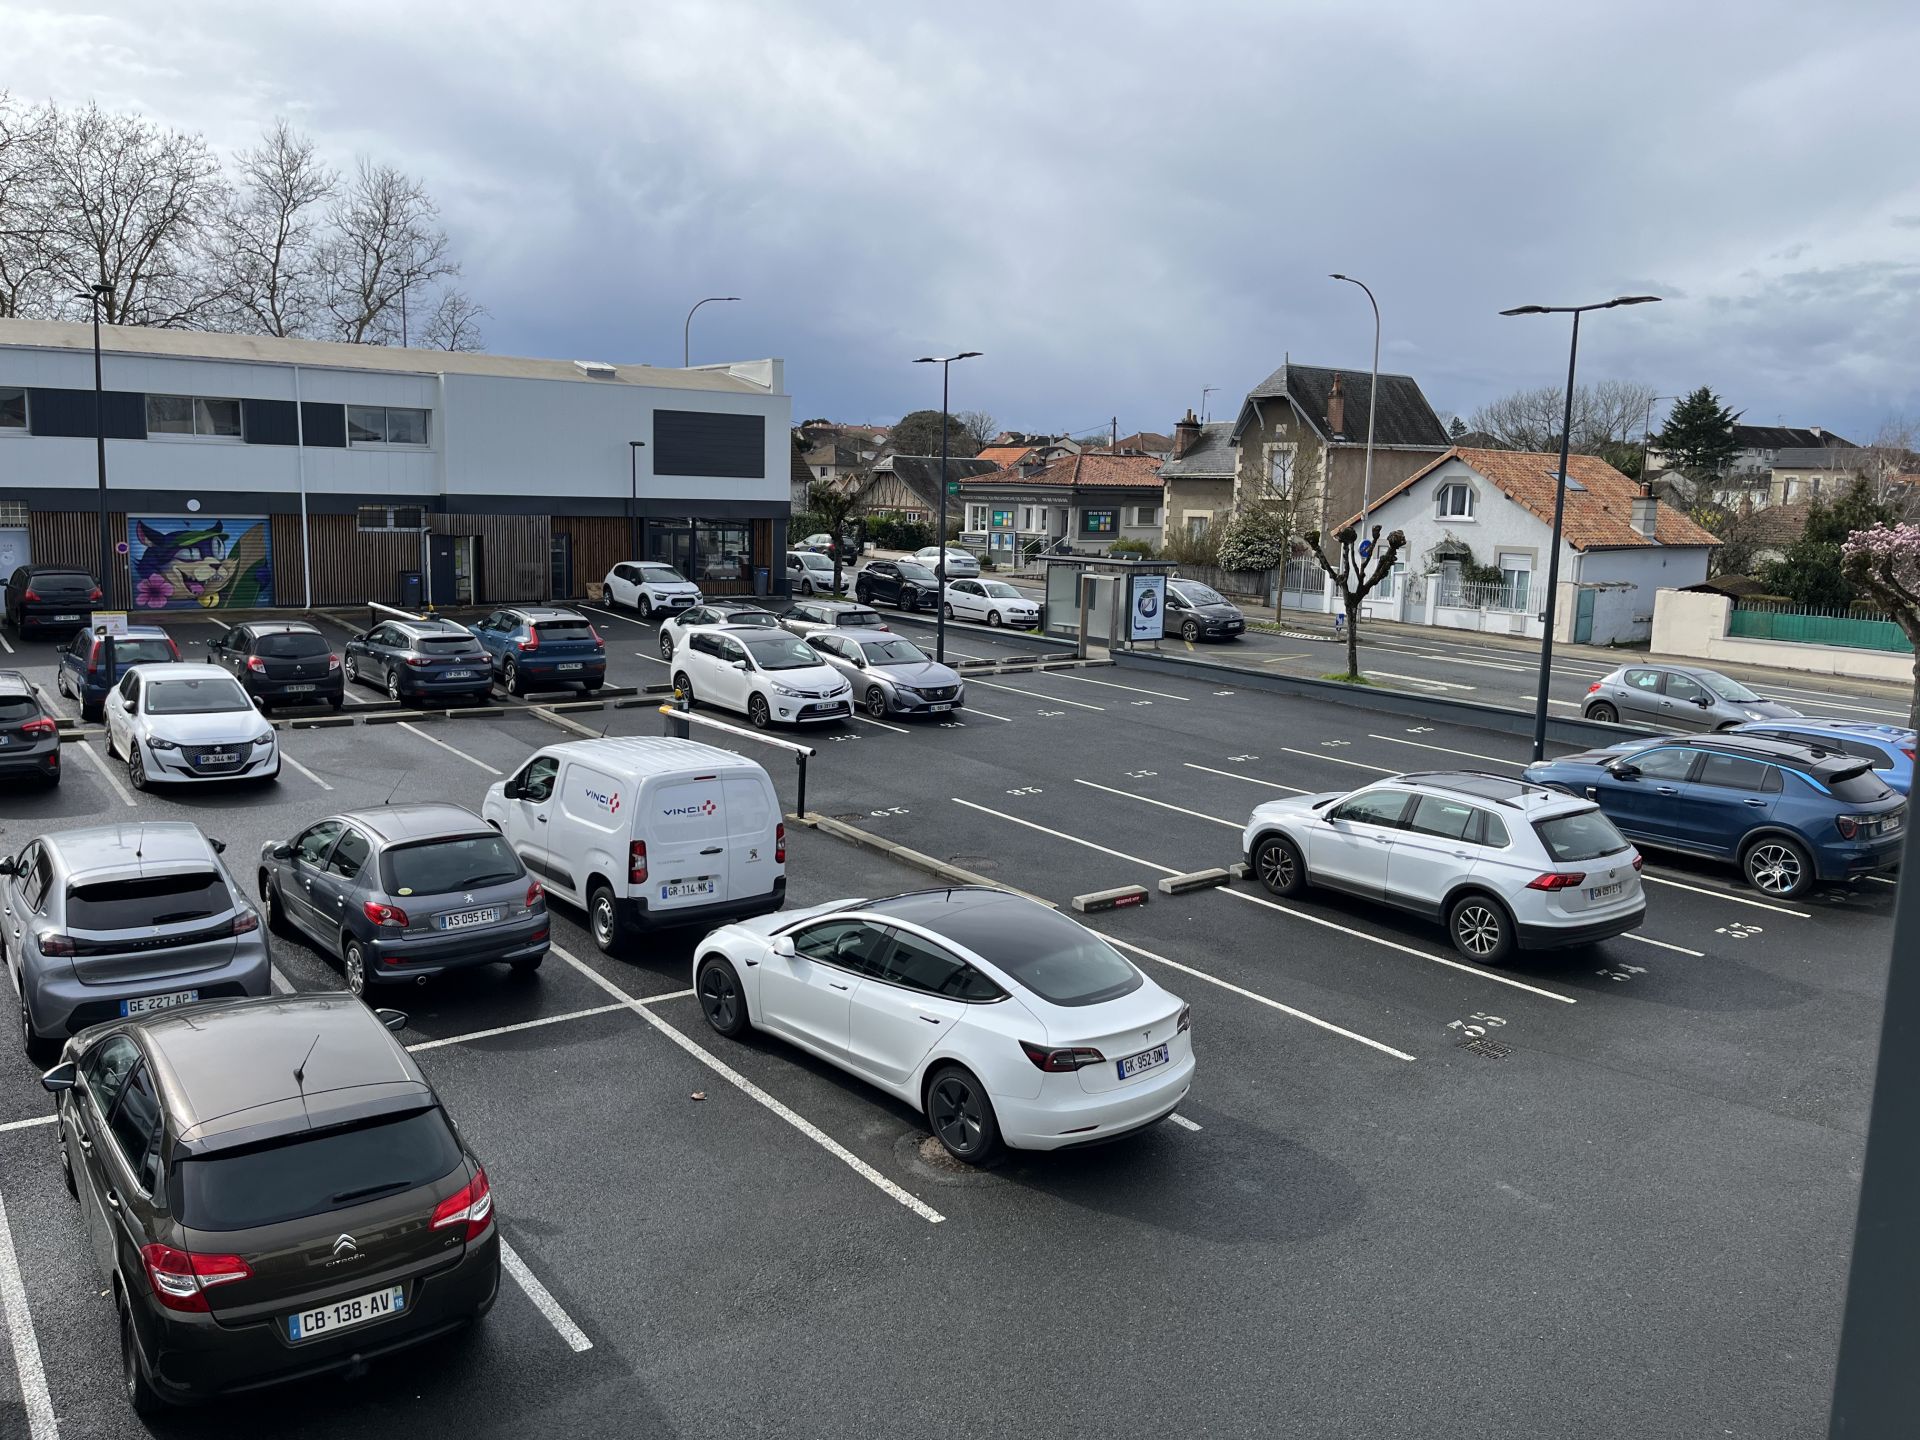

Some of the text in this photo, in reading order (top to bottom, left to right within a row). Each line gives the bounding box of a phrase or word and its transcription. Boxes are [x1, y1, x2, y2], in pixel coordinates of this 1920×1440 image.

[585, 788, 609, 805] VINCI
[663, 806, 701, 816] VINCI
[668, 882, 708, 896] GR-114-NK
[129, 993, 189, 1013] GE-227-AP
[1124, 1048, 1164, 1073] GK-952-DN
[303, 1291, 390, 1333] CB-138-AV
